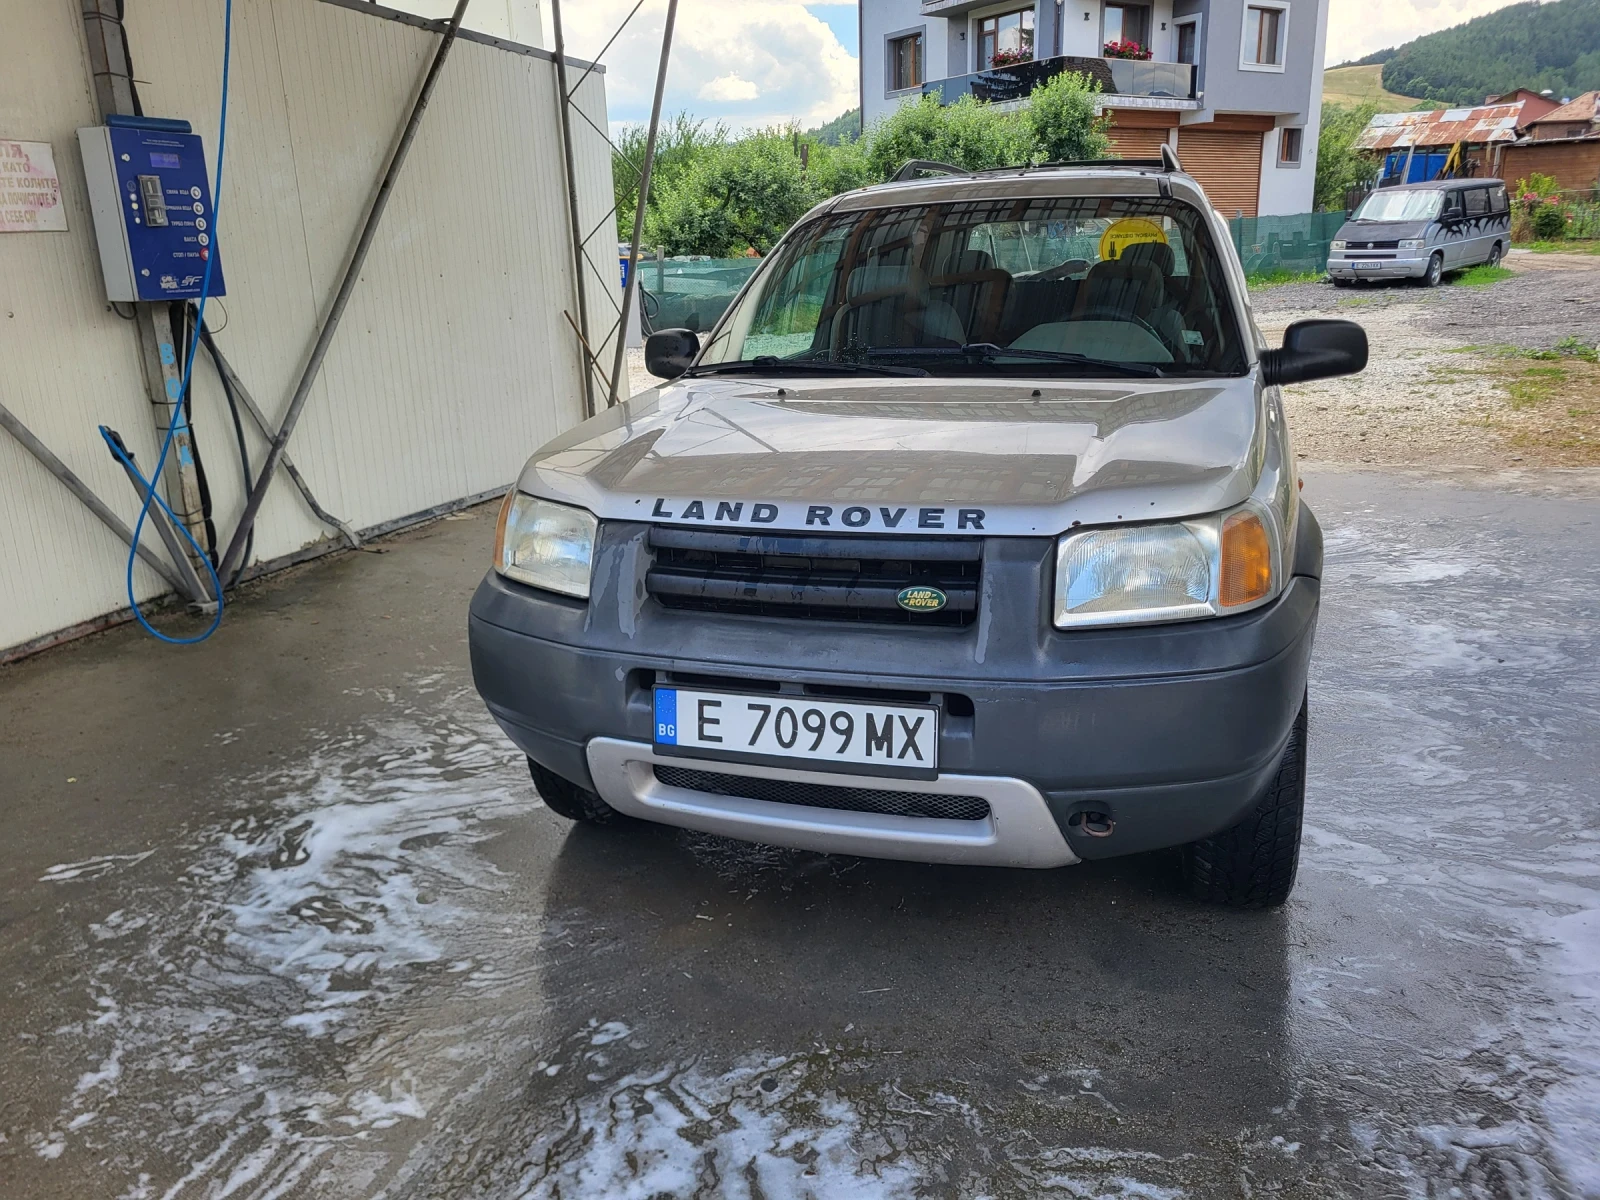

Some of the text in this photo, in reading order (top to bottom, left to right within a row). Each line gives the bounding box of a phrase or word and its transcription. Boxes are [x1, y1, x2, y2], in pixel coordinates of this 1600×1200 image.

[2, 162, 31, 173] КАТО
[17, 178, 58, 189] КОЛИТЕ
[651, 498, 986, 530] LAND ROVER
[658, 723, 675, 737] BG
[697, 698, 924, 760] E 7099 MX
